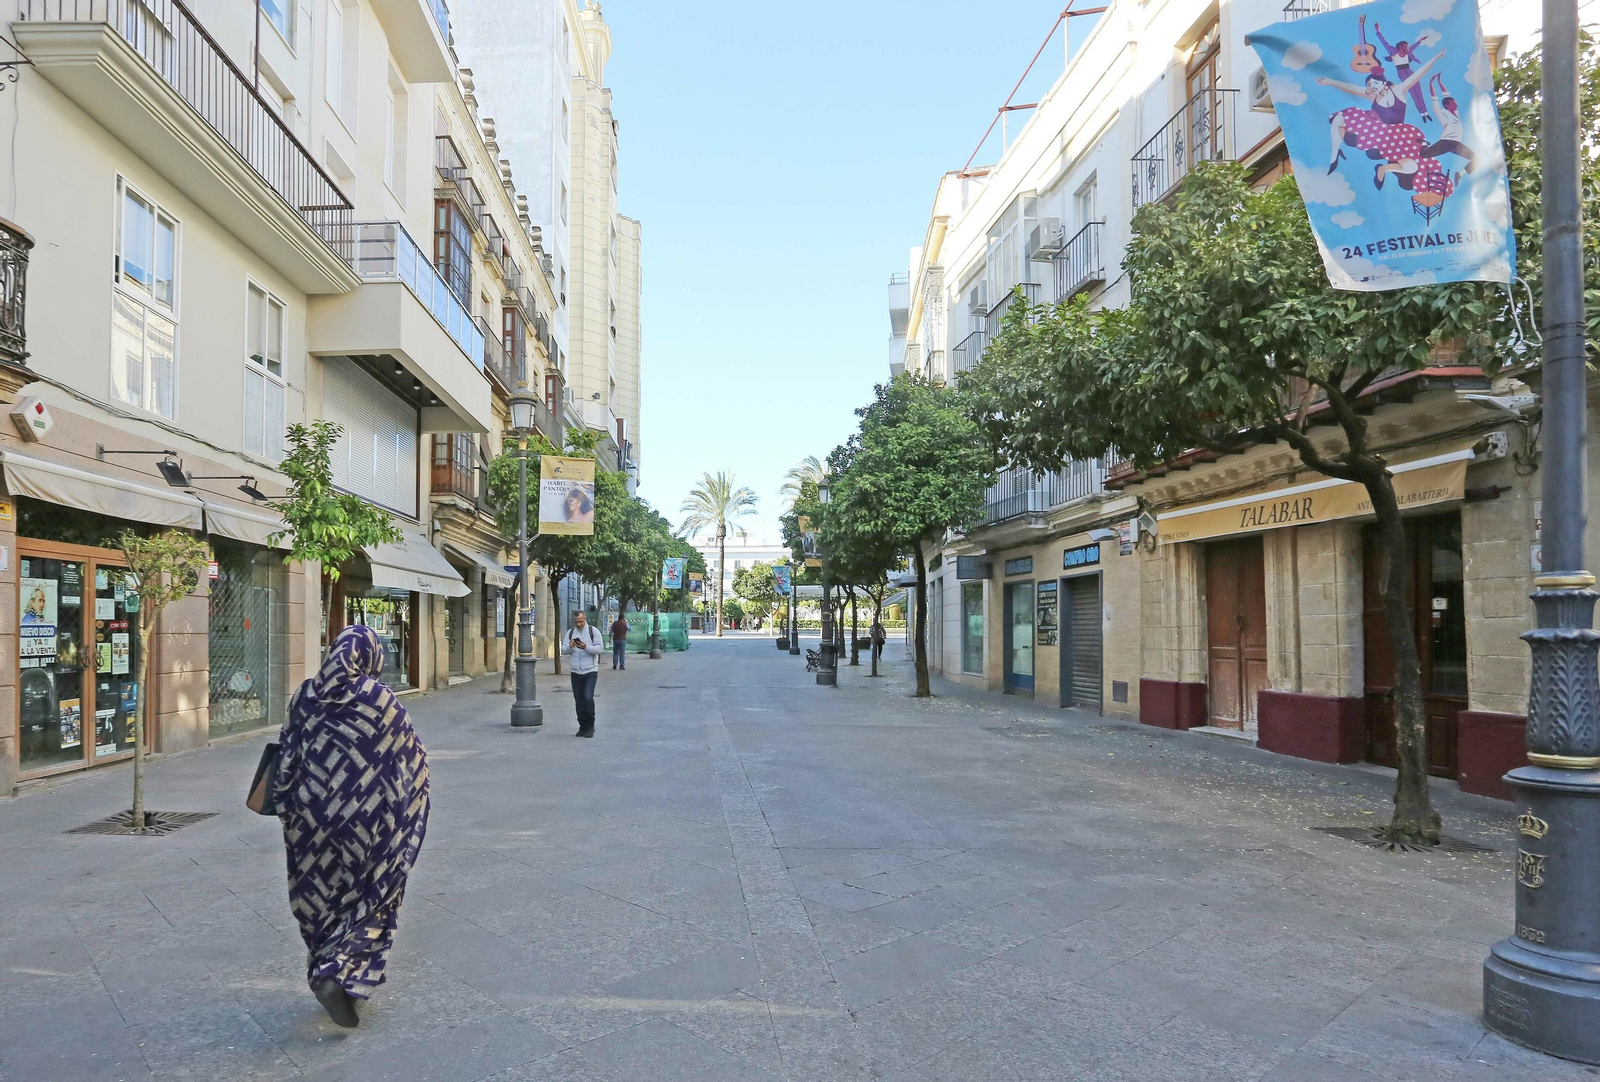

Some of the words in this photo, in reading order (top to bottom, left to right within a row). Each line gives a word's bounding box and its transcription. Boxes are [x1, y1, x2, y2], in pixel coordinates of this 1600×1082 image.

[1342, 246, 1363, 259] 24
[1366, 233, 1445, 256] FESTIVAL
[1447, 233, 1463, 245] DE
[1239, 497, 1314, 529] TALABAR
[1065, 548, 1086, 566] COMPRO
[1086, 545, 1099, 562] ORO
[20, 627, 39, 637] NUEVO
[39, 627, 54, 636] DISCO
[33, 638, 43, 646] YA
[35, 646, 56, 655] VENTA
